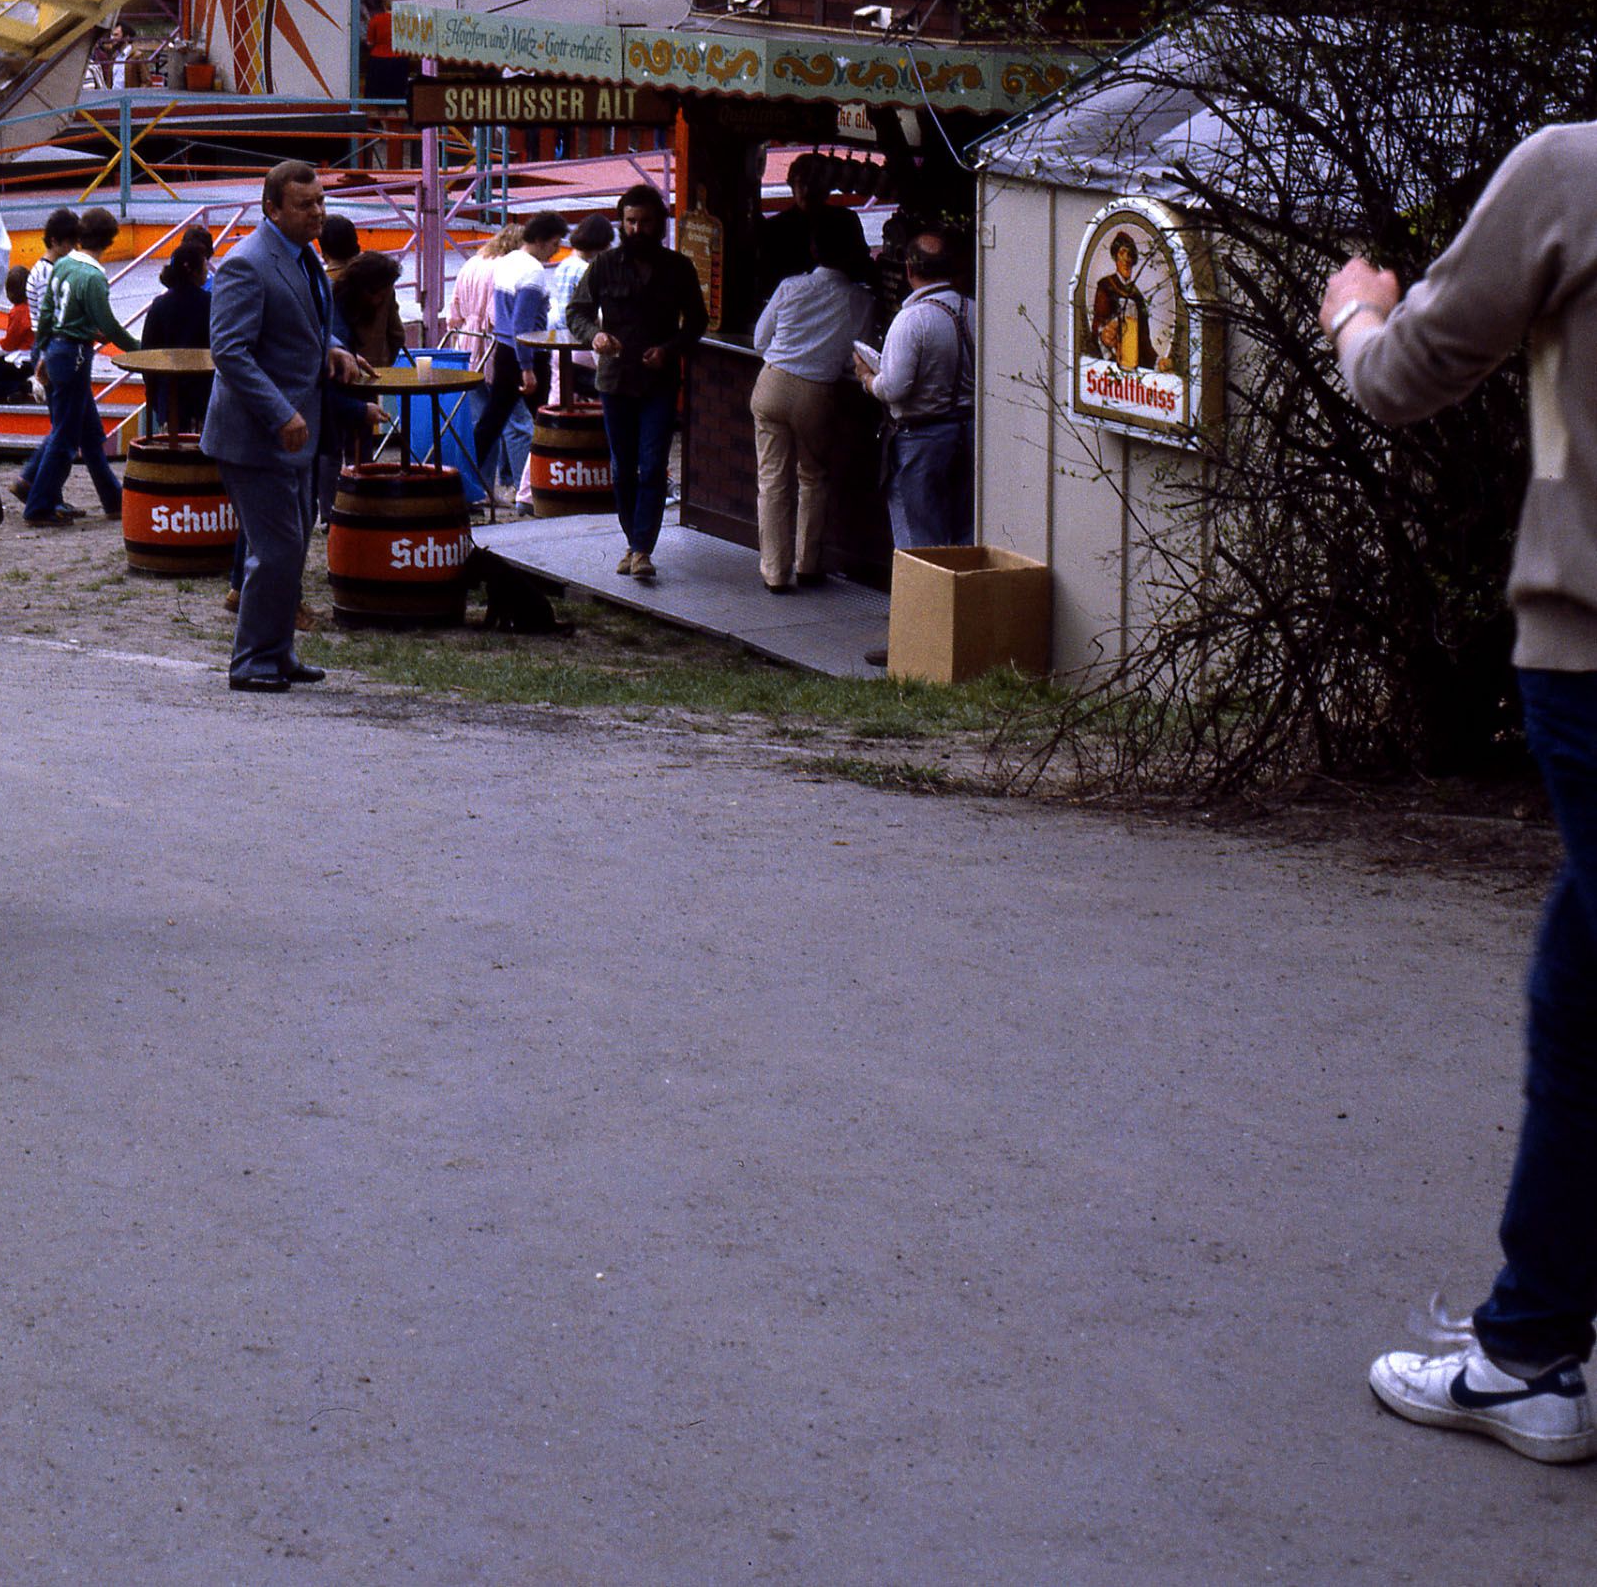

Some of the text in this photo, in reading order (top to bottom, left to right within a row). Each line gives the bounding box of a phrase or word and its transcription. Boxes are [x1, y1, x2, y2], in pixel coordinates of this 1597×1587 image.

[445, 18, 487, 54] Hopfen
[489, 25, 510, 51] und
[444, 84, 638, 121] SCHLÖSSER ALT
[1086, 368, 1176, 412] Schultheiss
[151, 503, 240, 533] Schult
